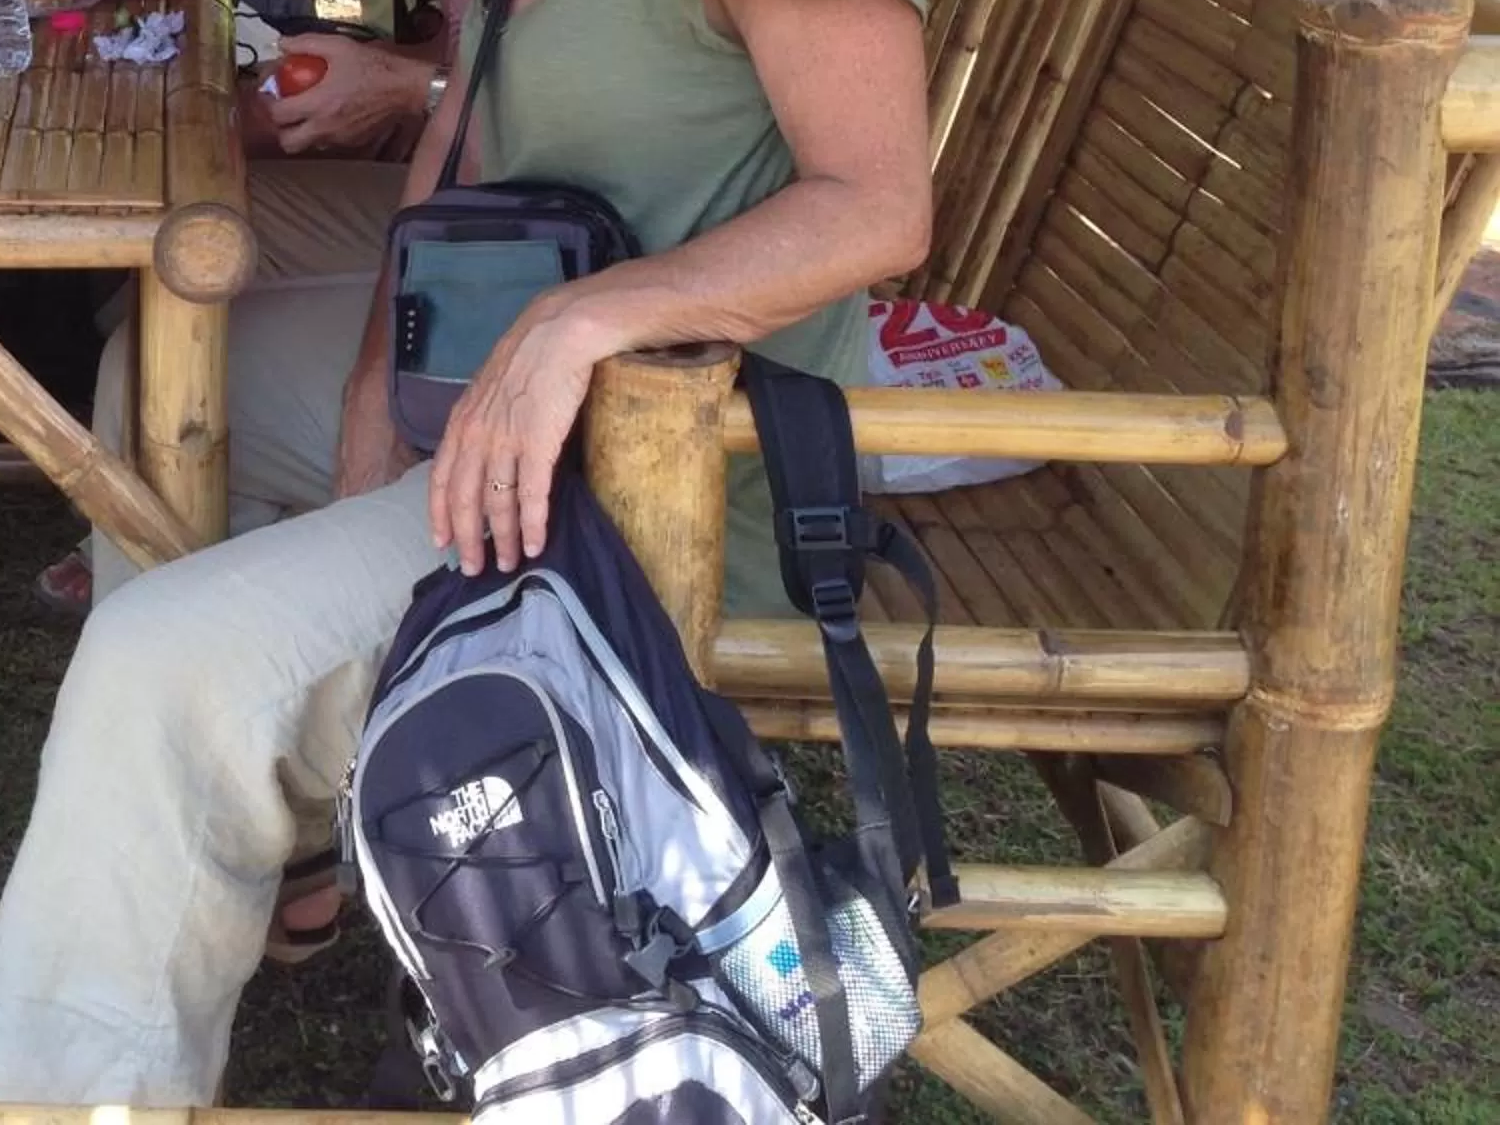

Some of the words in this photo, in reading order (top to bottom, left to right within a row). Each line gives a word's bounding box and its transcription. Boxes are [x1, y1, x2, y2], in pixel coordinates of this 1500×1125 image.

[899, 333, 997, 363] ANNIVERSARY
[450, 780, 483, 807] THE
[429, 794, 490, 835] NORTH
